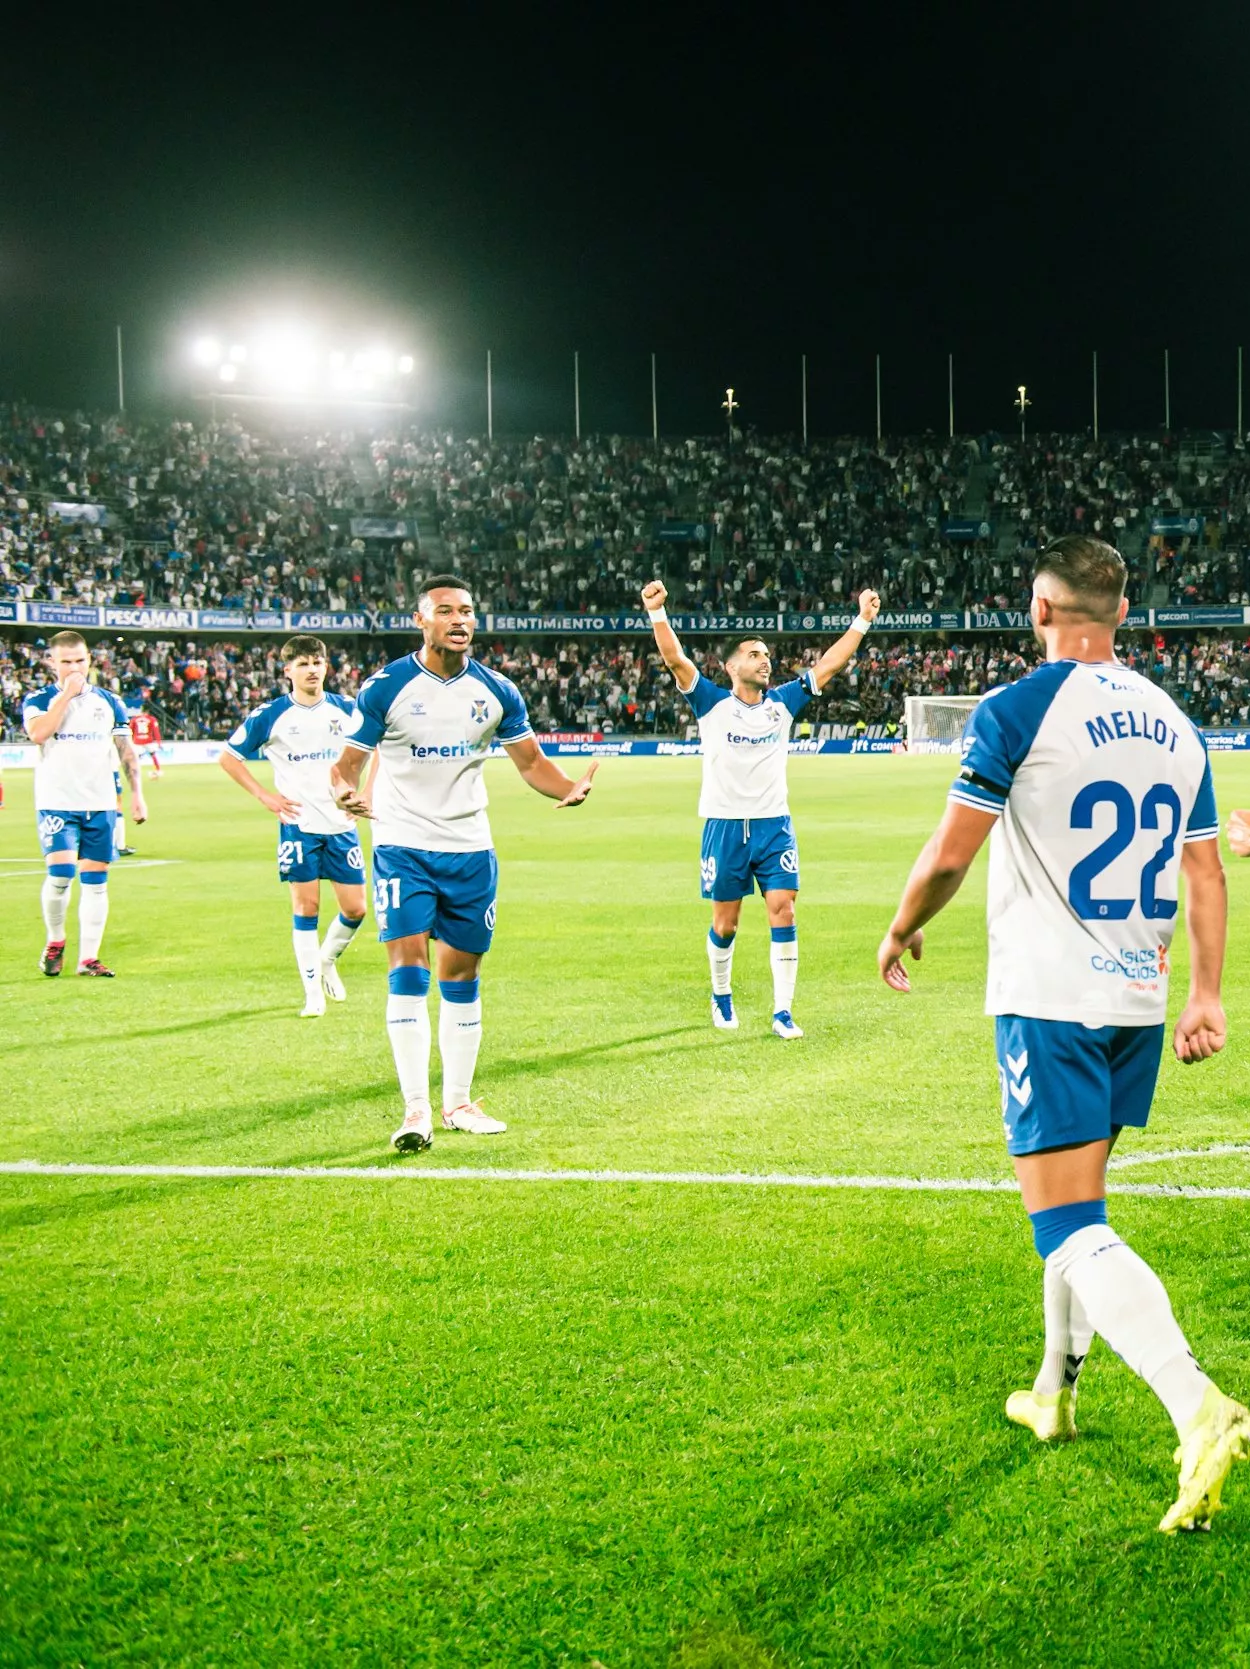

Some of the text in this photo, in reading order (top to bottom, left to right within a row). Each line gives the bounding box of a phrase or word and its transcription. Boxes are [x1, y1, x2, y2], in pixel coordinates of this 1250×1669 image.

[107, 609, 190, 628] PESCAMAR
[496, 617, 605, 629] SENTIMIENTO
[610, 617, 619, 629] Y
[976, 612, 1000, 627] DA
[1085, 710, 1179, 753] MELLOT
[1069, 779, 1181, 920] 22
